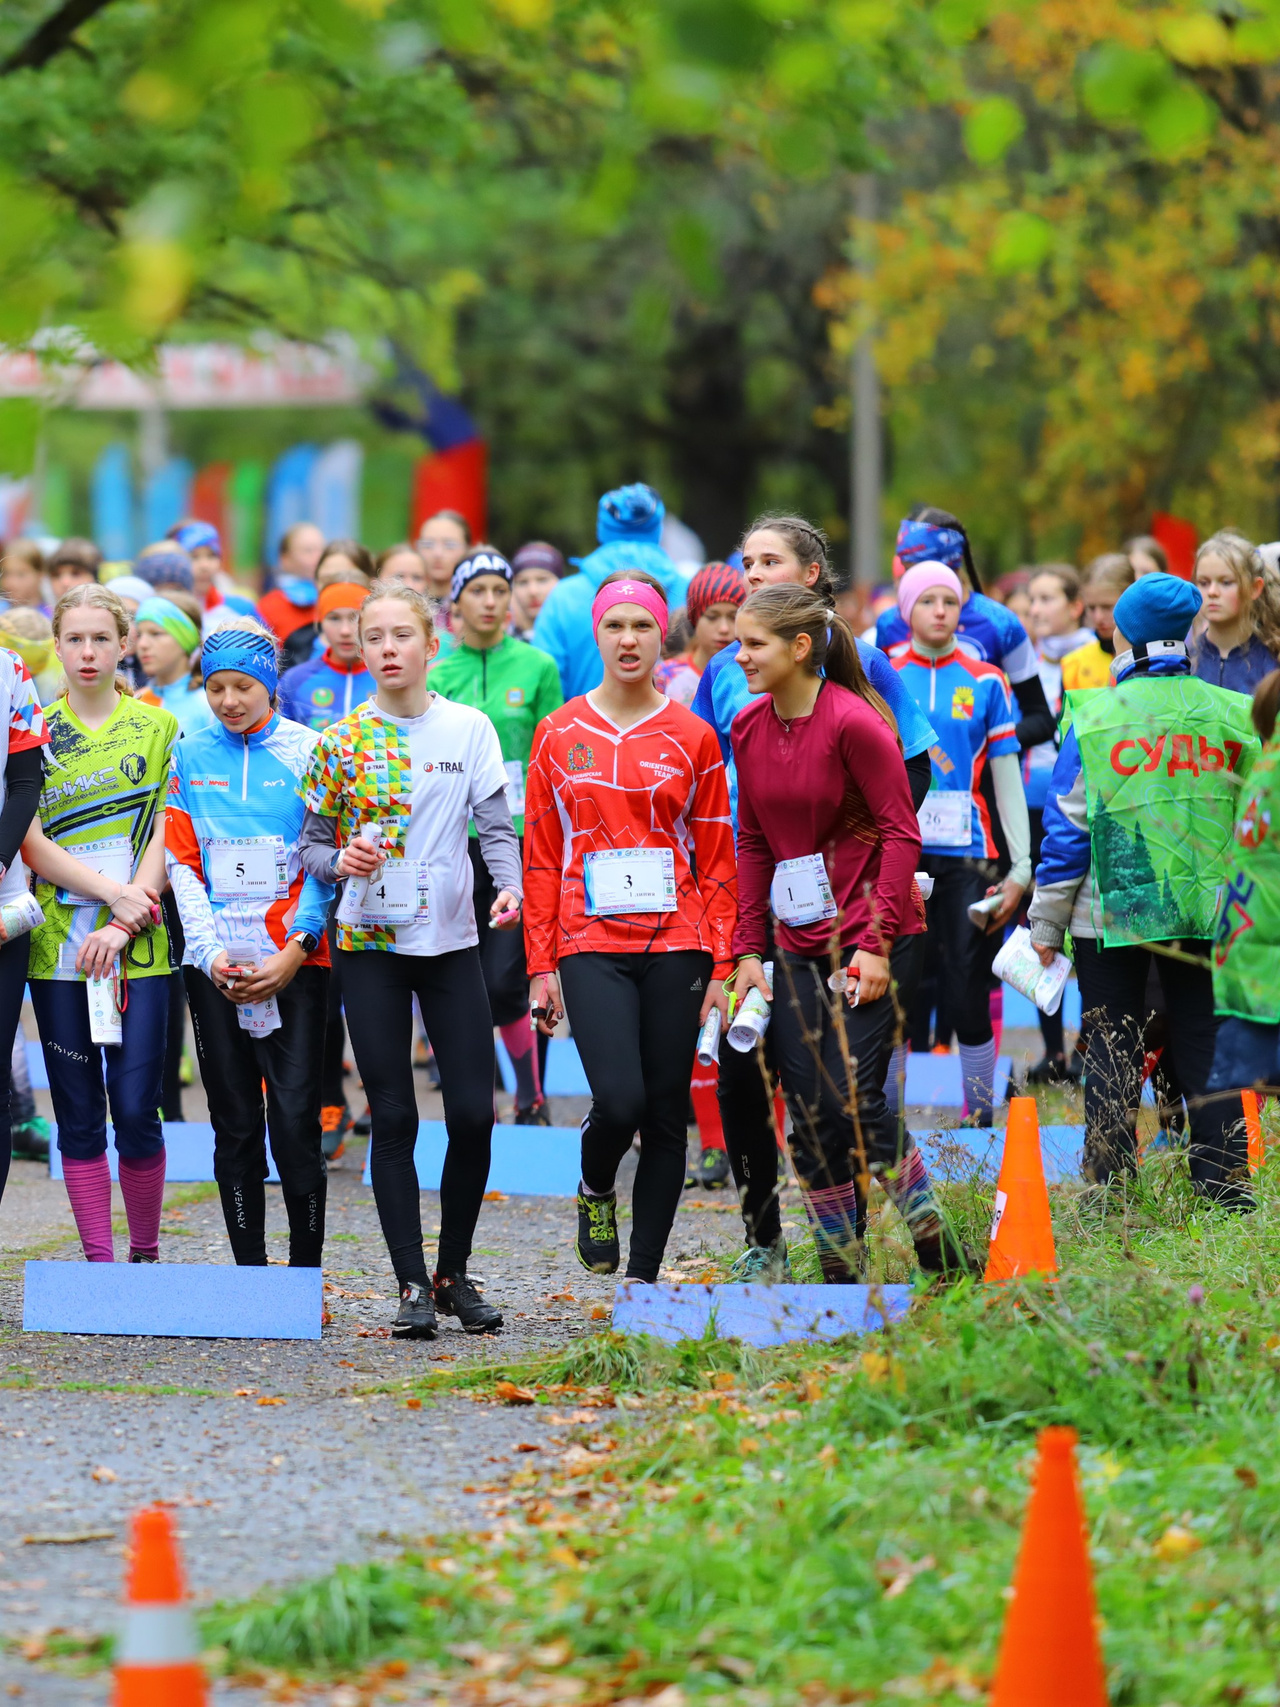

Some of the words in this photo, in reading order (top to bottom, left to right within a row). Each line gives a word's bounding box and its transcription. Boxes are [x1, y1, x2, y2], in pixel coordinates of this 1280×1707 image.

[640, 761, 684, 777] ORIENTEERING
[236, 863, 245, 877] 5
[624, 875, 632, 889] 3
[376, 885, 386, 899] 4
[788, 887, 793, 901] 1
